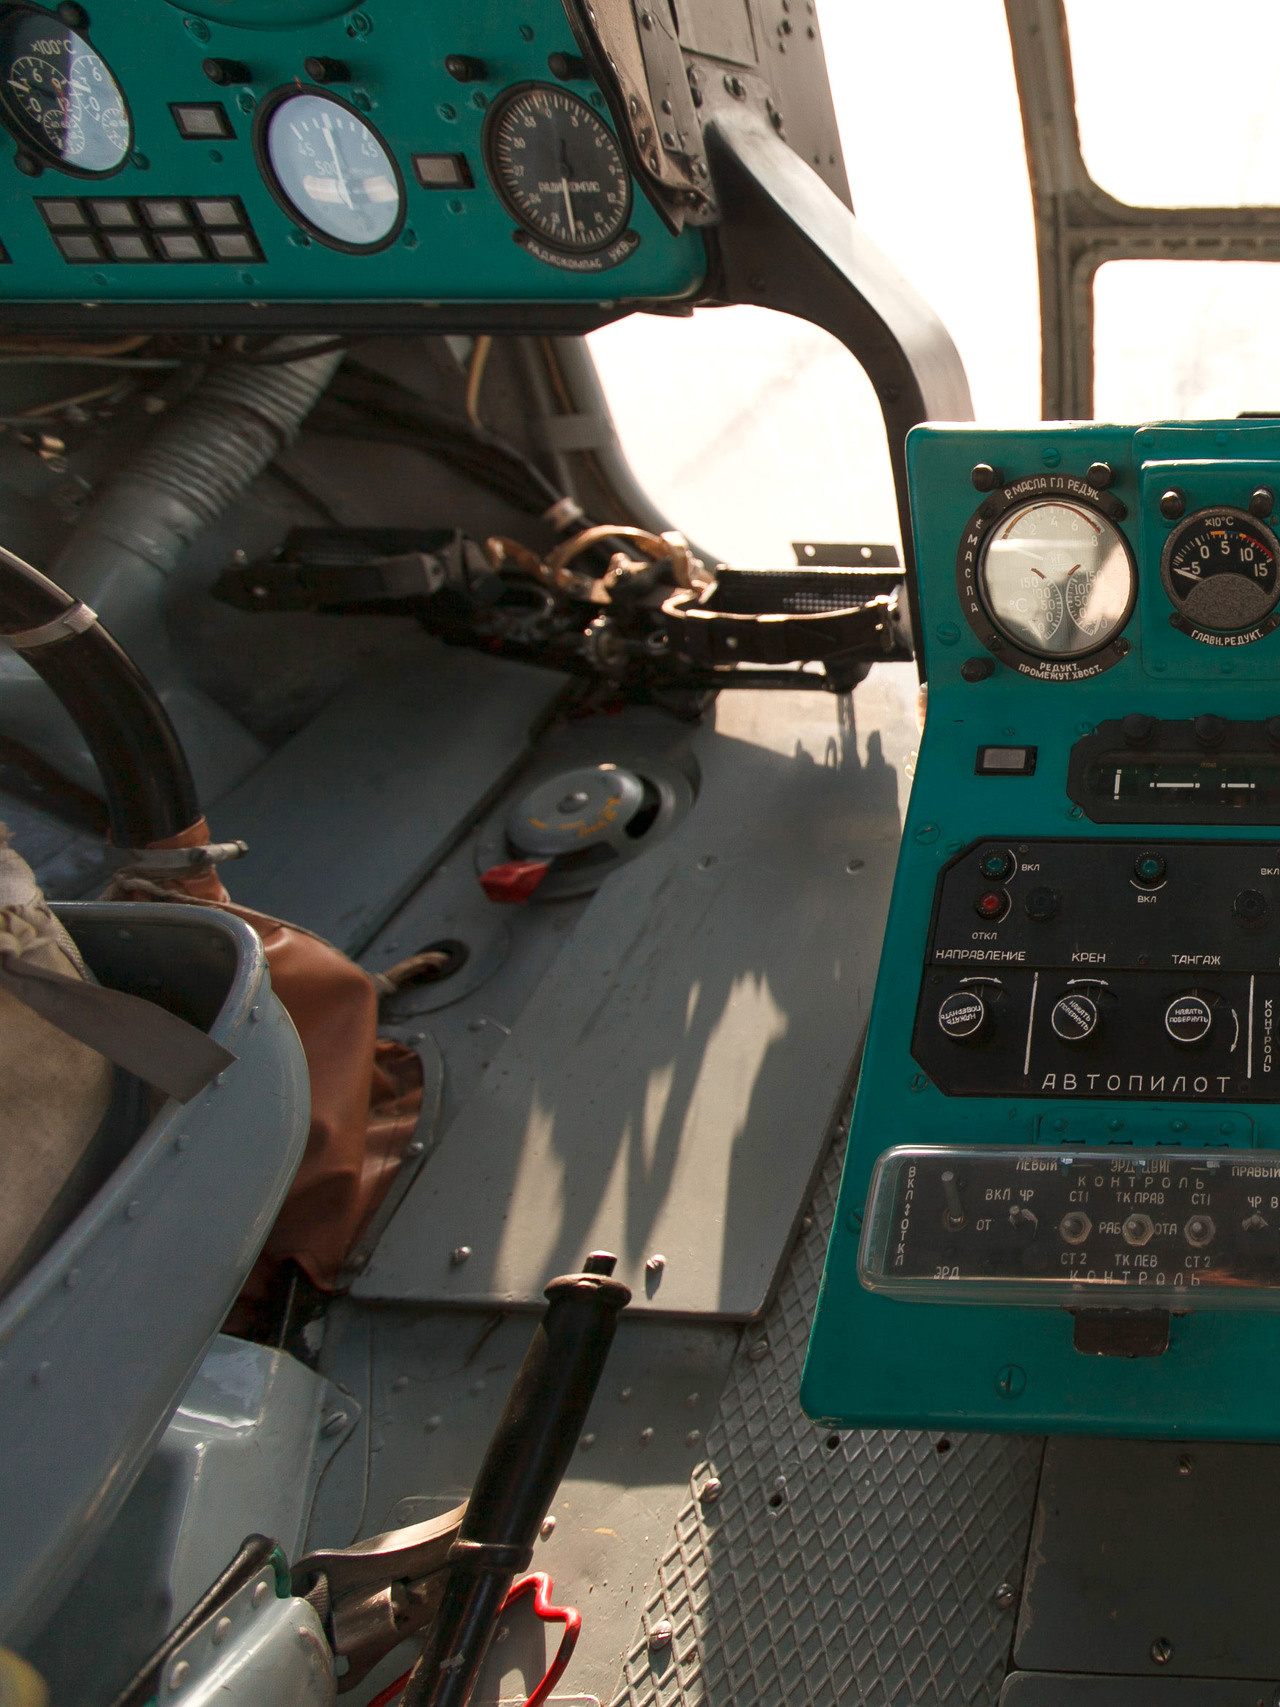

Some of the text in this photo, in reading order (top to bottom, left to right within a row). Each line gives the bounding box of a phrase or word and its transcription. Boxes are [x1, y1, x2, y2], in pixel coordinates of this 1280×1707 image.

[32, 68, 42, 83] 6
[608, 240, 630, 262] УКВ
[1050, 478, 1064, 488] ГЛ
[1067, 480, 1100, 500] РЕДУК.
[1050, 516, 1058, 528] 4
[1071, 520, 1079, 532] 6
[1030, 524, 1038, 535] 2
[1091, 536, 1099, 547] 8
[1220, 540, 1230, 555] 5
[1200, 544, 1210, 559] 0
[1240, 548, 1254, 562] 10
[965, 534, 979, 614] МАСЛА
[1254, 562, 1268, 577] 15
[1020, 576, 1039, 590] 150
[1032, 587, 1051, 600] 100
[1040, 600, 1056, 610] 50
[1045, 612, 1054, 623] 0
[1079, 606, 1087, 618] 0
[1040, 662, 1080, 672] РЕДУКТ.
[1021, 862, 1040, 872] ВКЛ
[1260, 867, 1280, 876] ВКЛ
[1136, 894, 1158, 904] ВКЛ
[971, 932, 998, 940] ОТКЛ
[936, 949, 1026, 962] НАПРАВЛЕНИЕ
[1071, 952, 1107, 964] КРЕН
[1171, 954, 1222, 966] ТАНГАЖ
[1264, 1000, 1273, 1073] КОНТРОЛЬ
[1040, 1073, 1232, 1094] АВТОПИЛОТ
[1016, 1158, 1058, 1172] ЛЕВЫЙ
[1078, 1176, 1205, 1190] КОНТРОЛЬ
[985, 1188, 1035, 1202] ВКЛ ЧР
[1114, 1192, 1165, 1204] ТК ПРАВ
[1247, 1196, 1262, 1208] ЧР
[895, 1166, 916, 1266] ВКЛ ОТКЛ
[1098, 1222, 1122, 1235] РАБ
[1154, 1222, 1178, 1236] ОТА
[1114, 1254, 1158, 1268] ТК ЛЕВ
[934, 1266, 960, 1280] ЭРД
[1070, 1270, 1202, 1286] КОНТРОЛЬ
